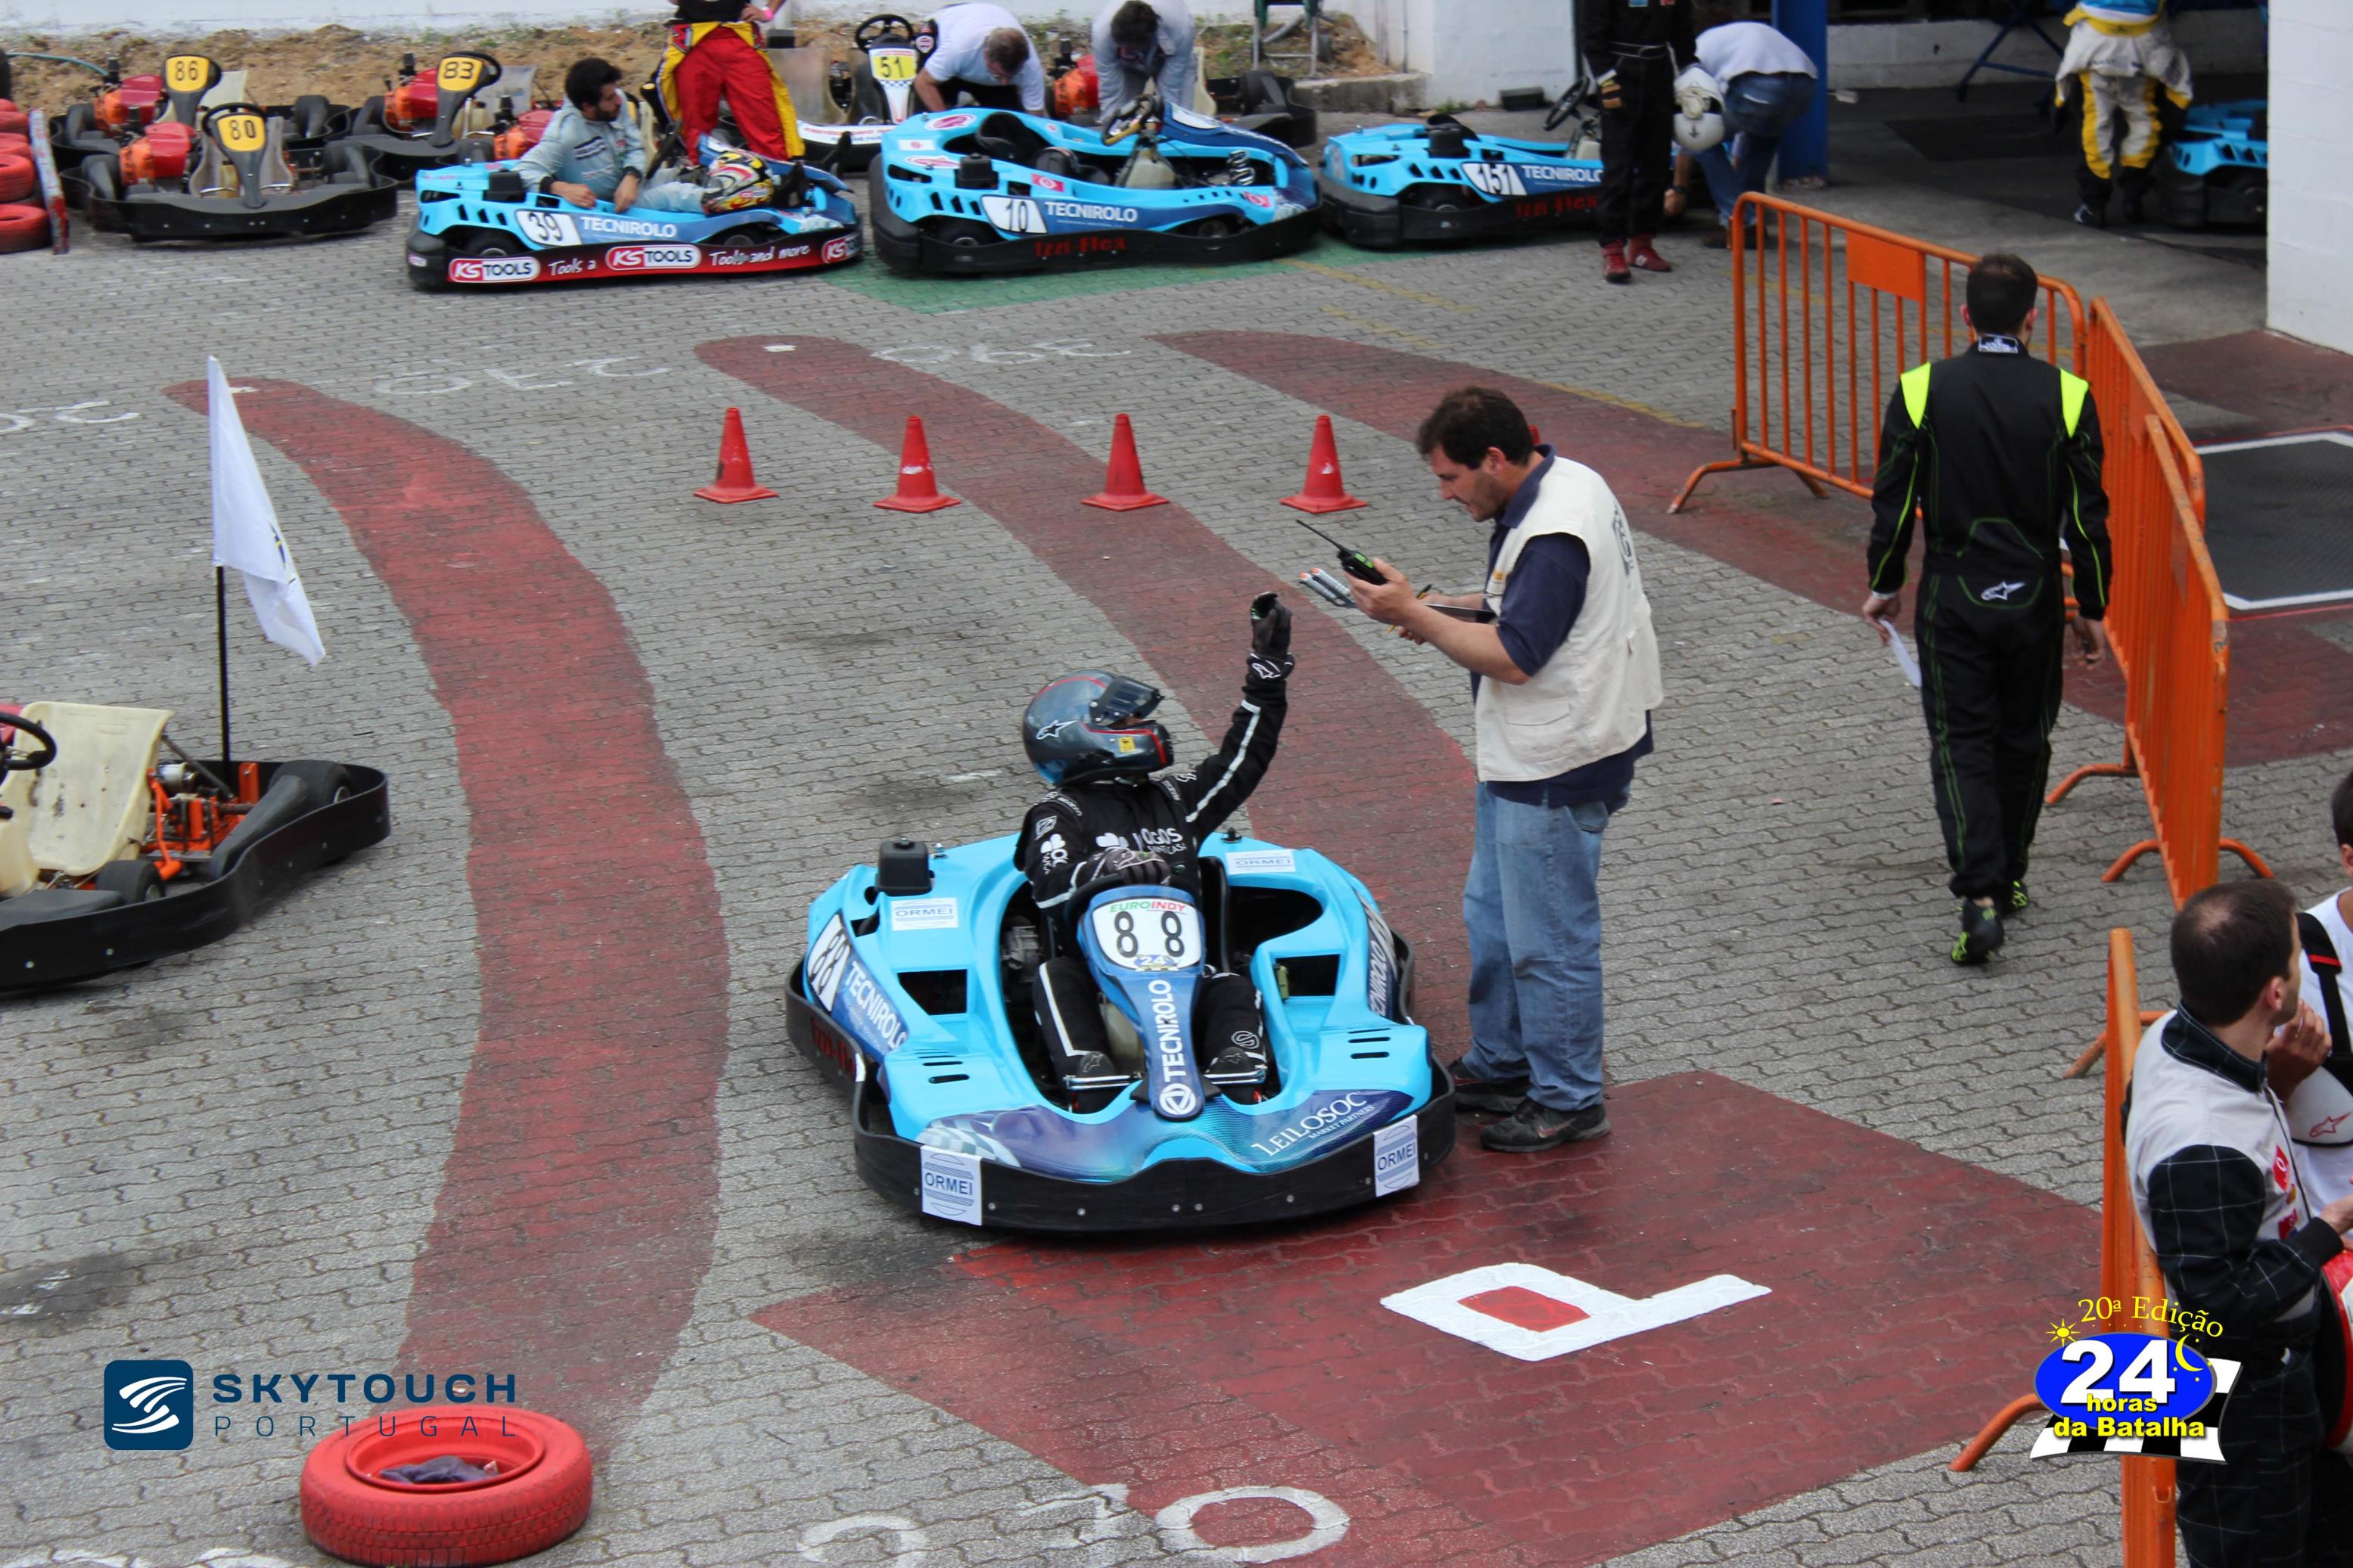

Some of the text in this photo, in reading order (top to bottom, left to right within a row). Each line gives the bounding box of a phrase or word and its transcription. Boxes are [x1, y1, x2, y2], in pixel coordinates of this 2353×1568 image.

[175, 60, 199, 82] 86
[443, 61, 474, 79] 83
[880, 56, 904, 79] 51
[228, 119, 257, 141] 80
[1475, 163, 1513, 195] 151
[1006, 198, 1029, 233] 10
[1044, 200, 1139, 223] TECNIROLO
[528, 211, 564, 242] 39
[580, 216, 679, 238] TECNIROLO
[748, 246, 776, 262] and
[778, 244, 811, 259] more
[547, 257, 583, 276] Tools
[894, 907, 953, 918] ORMEI
[1147, 980, 1187, 1083] TECNIROLO
[1250, 1091, 1368, 1157] LEILOSOC
[1308, 1104, 1375, 1141] MARKET PARTNERS
[1376, 1141, 1417, 1172] ORMEI
[924, 1172, 974, 1197] ORMEI
